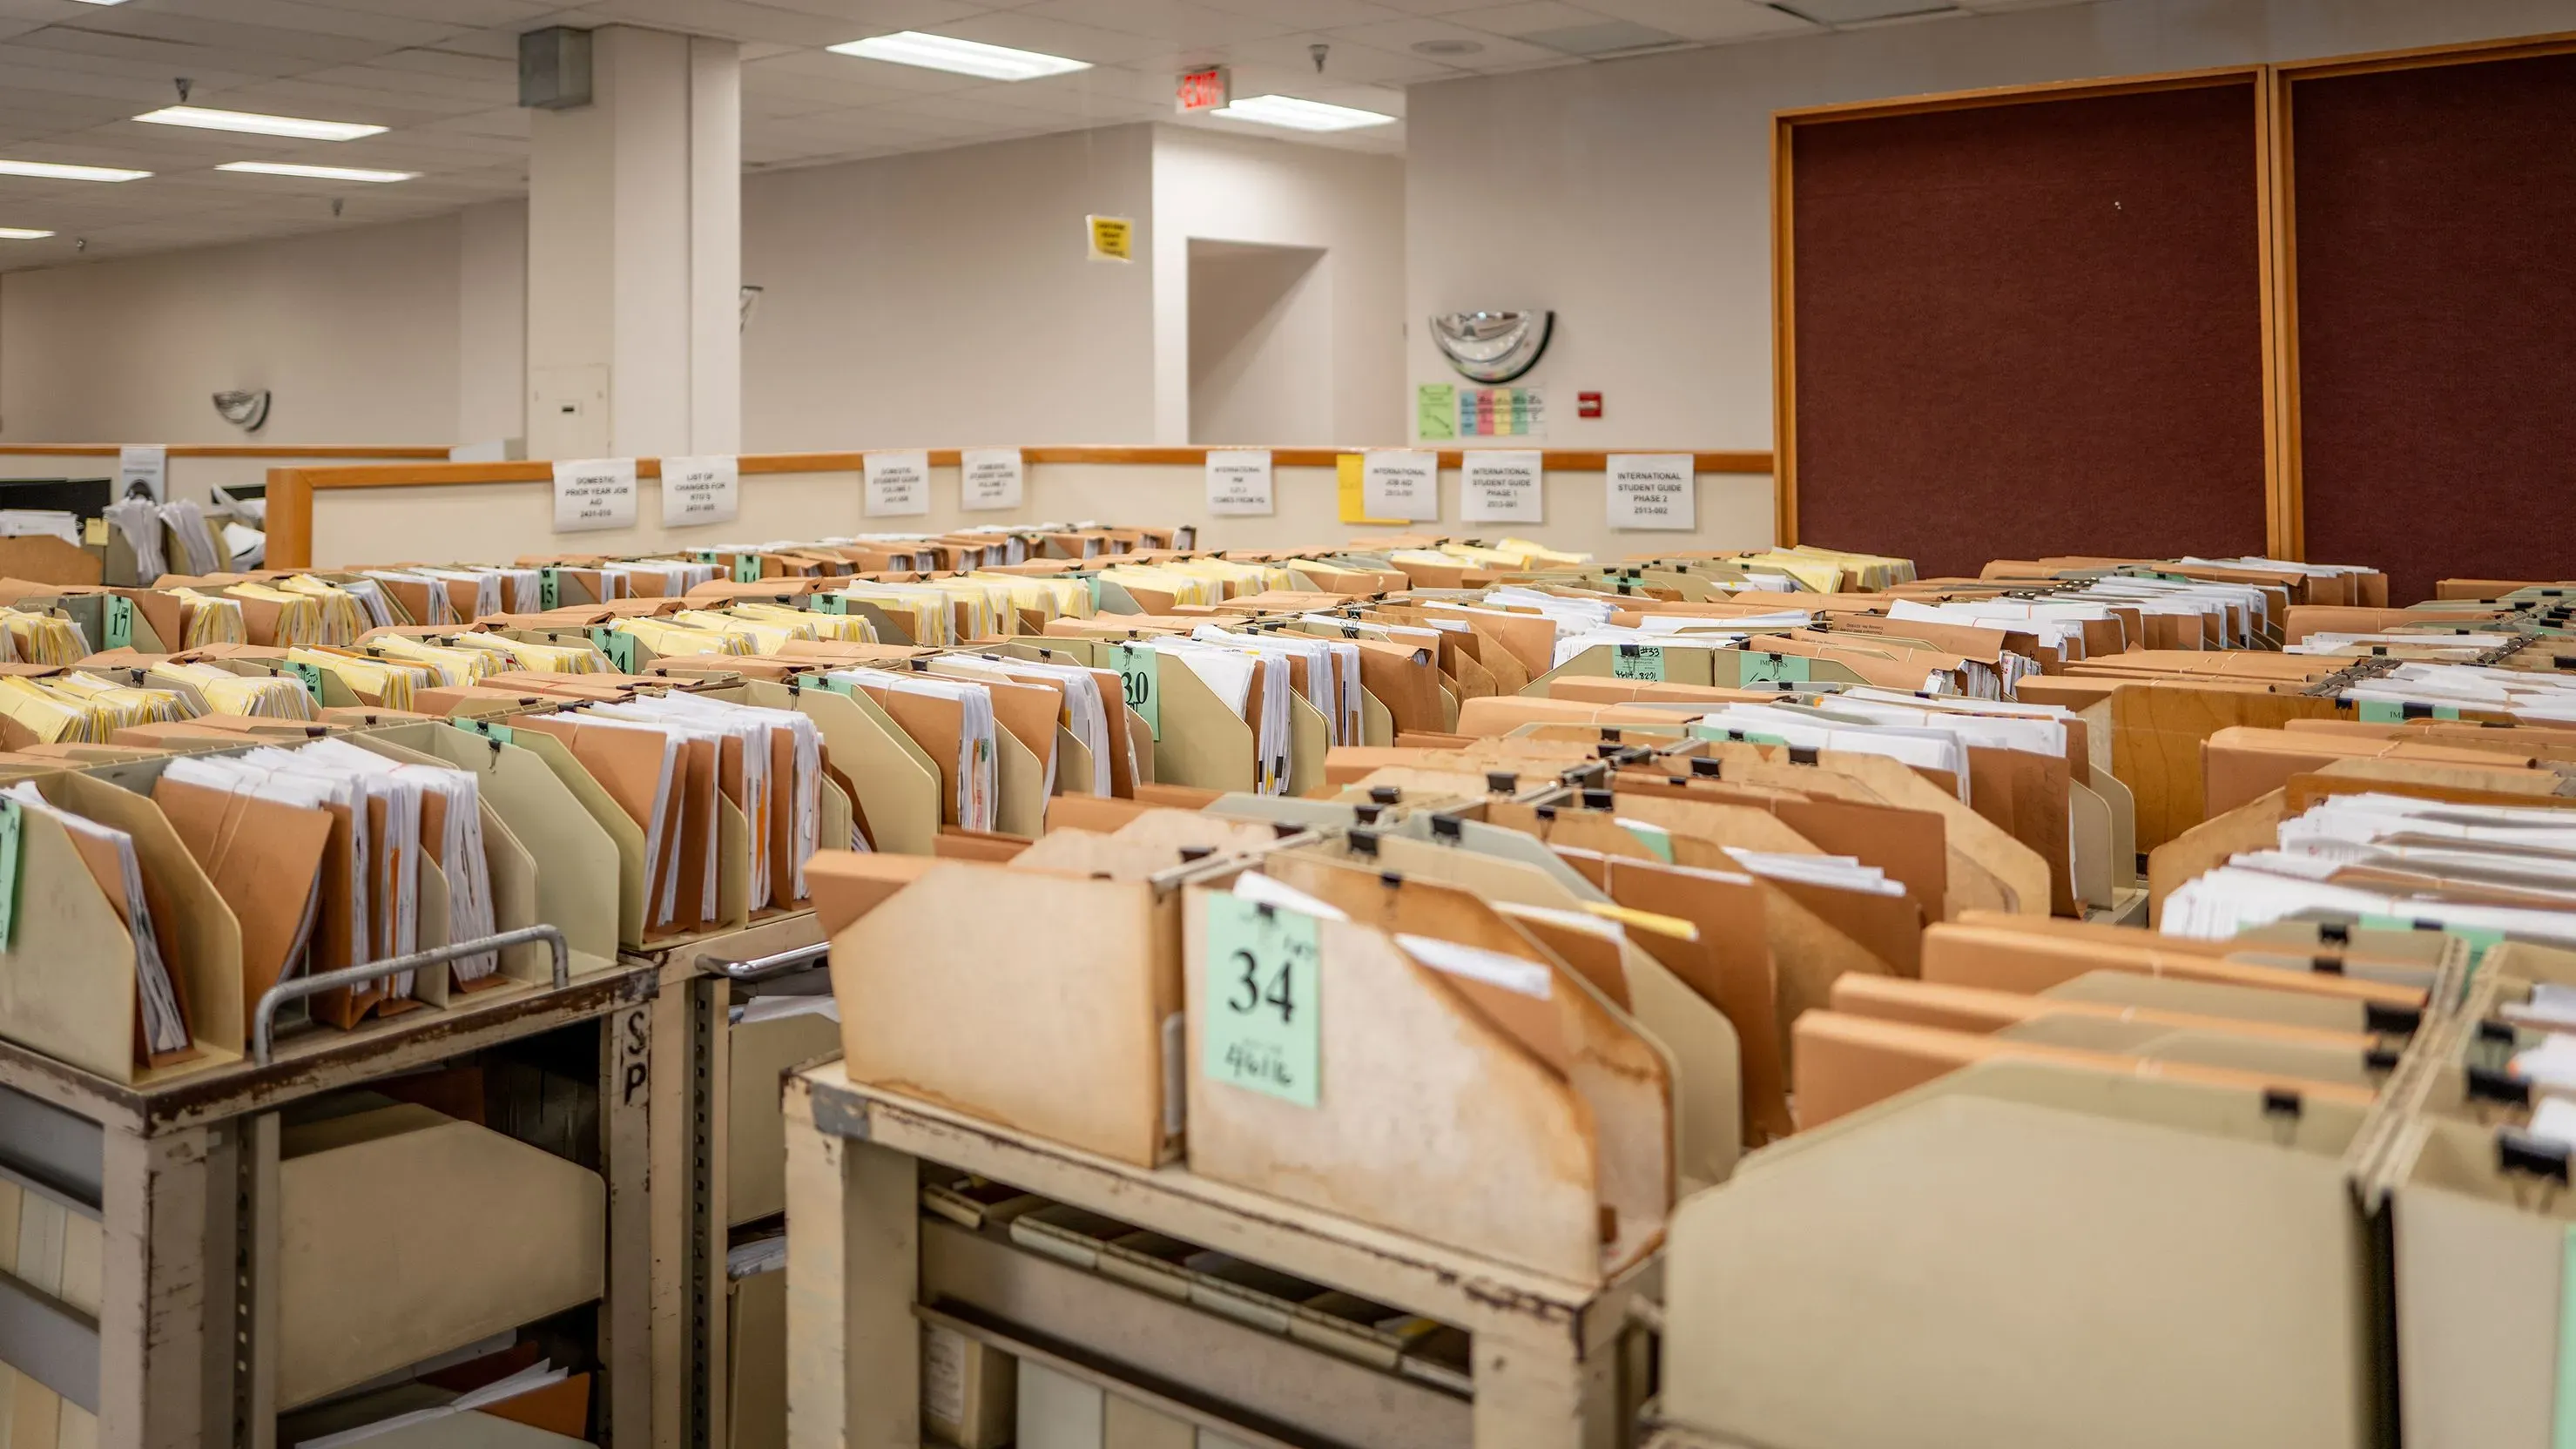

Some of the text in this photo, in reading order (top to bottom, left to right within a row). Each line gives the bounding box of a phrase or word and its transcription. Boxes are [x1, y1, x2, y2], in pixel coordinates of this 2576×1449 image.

[1184, 71, 1217, 109] EXIT
[1472, 467, 1531, 475] INTERNATIONAL
[1617, 472, 1682, 481] INTERNATIONAL
[576, 475, 615, 485] DOMESTIC
[1473, 478, 1531, 487] STUDENT GUIDE
[541, 583, 553, 603] 15
[112, 612, 128, 637] 17
[1640, 646, 1660, 657] #33
[1121, 671, 1149, 704] 30
[1227, 947, 1295, 1025] 34
